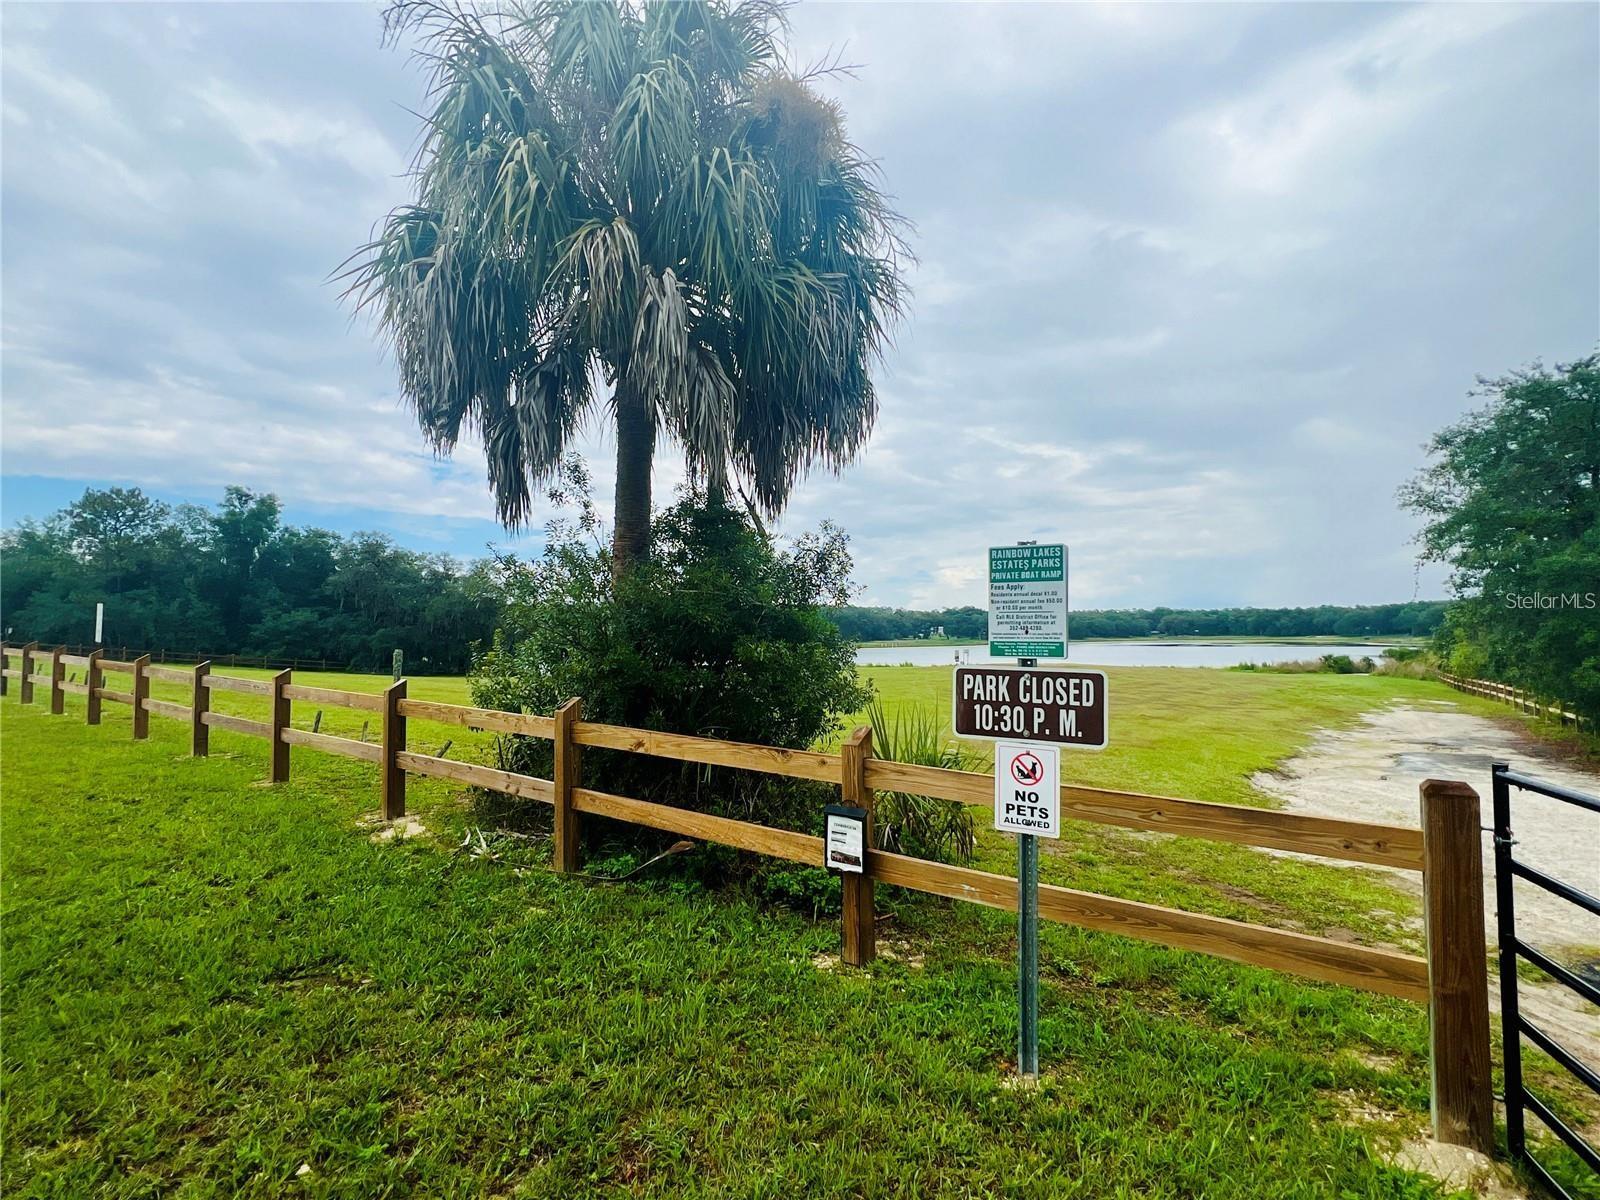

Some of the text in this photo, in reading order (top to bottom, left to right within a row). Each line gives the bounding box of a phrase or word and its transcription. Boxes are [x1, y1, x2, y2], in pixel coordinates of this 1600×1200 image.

[991, 547, 1061, 559] RAINBOW LAKES
[992, 558, 1061, 570] ESTATES PARKS
[991, 570, 1062, 580] PRIVATE BOAT RAMP
[963, 673, 1095, 707] PARK CLOSED
[973, 703, 1083, 738] 10:30 P. M.
[1014, 789, 1040, 804] NO
[1005, 803, 1049, 820] PETS
[1003, 816, 1050, 829] ALLOWED
